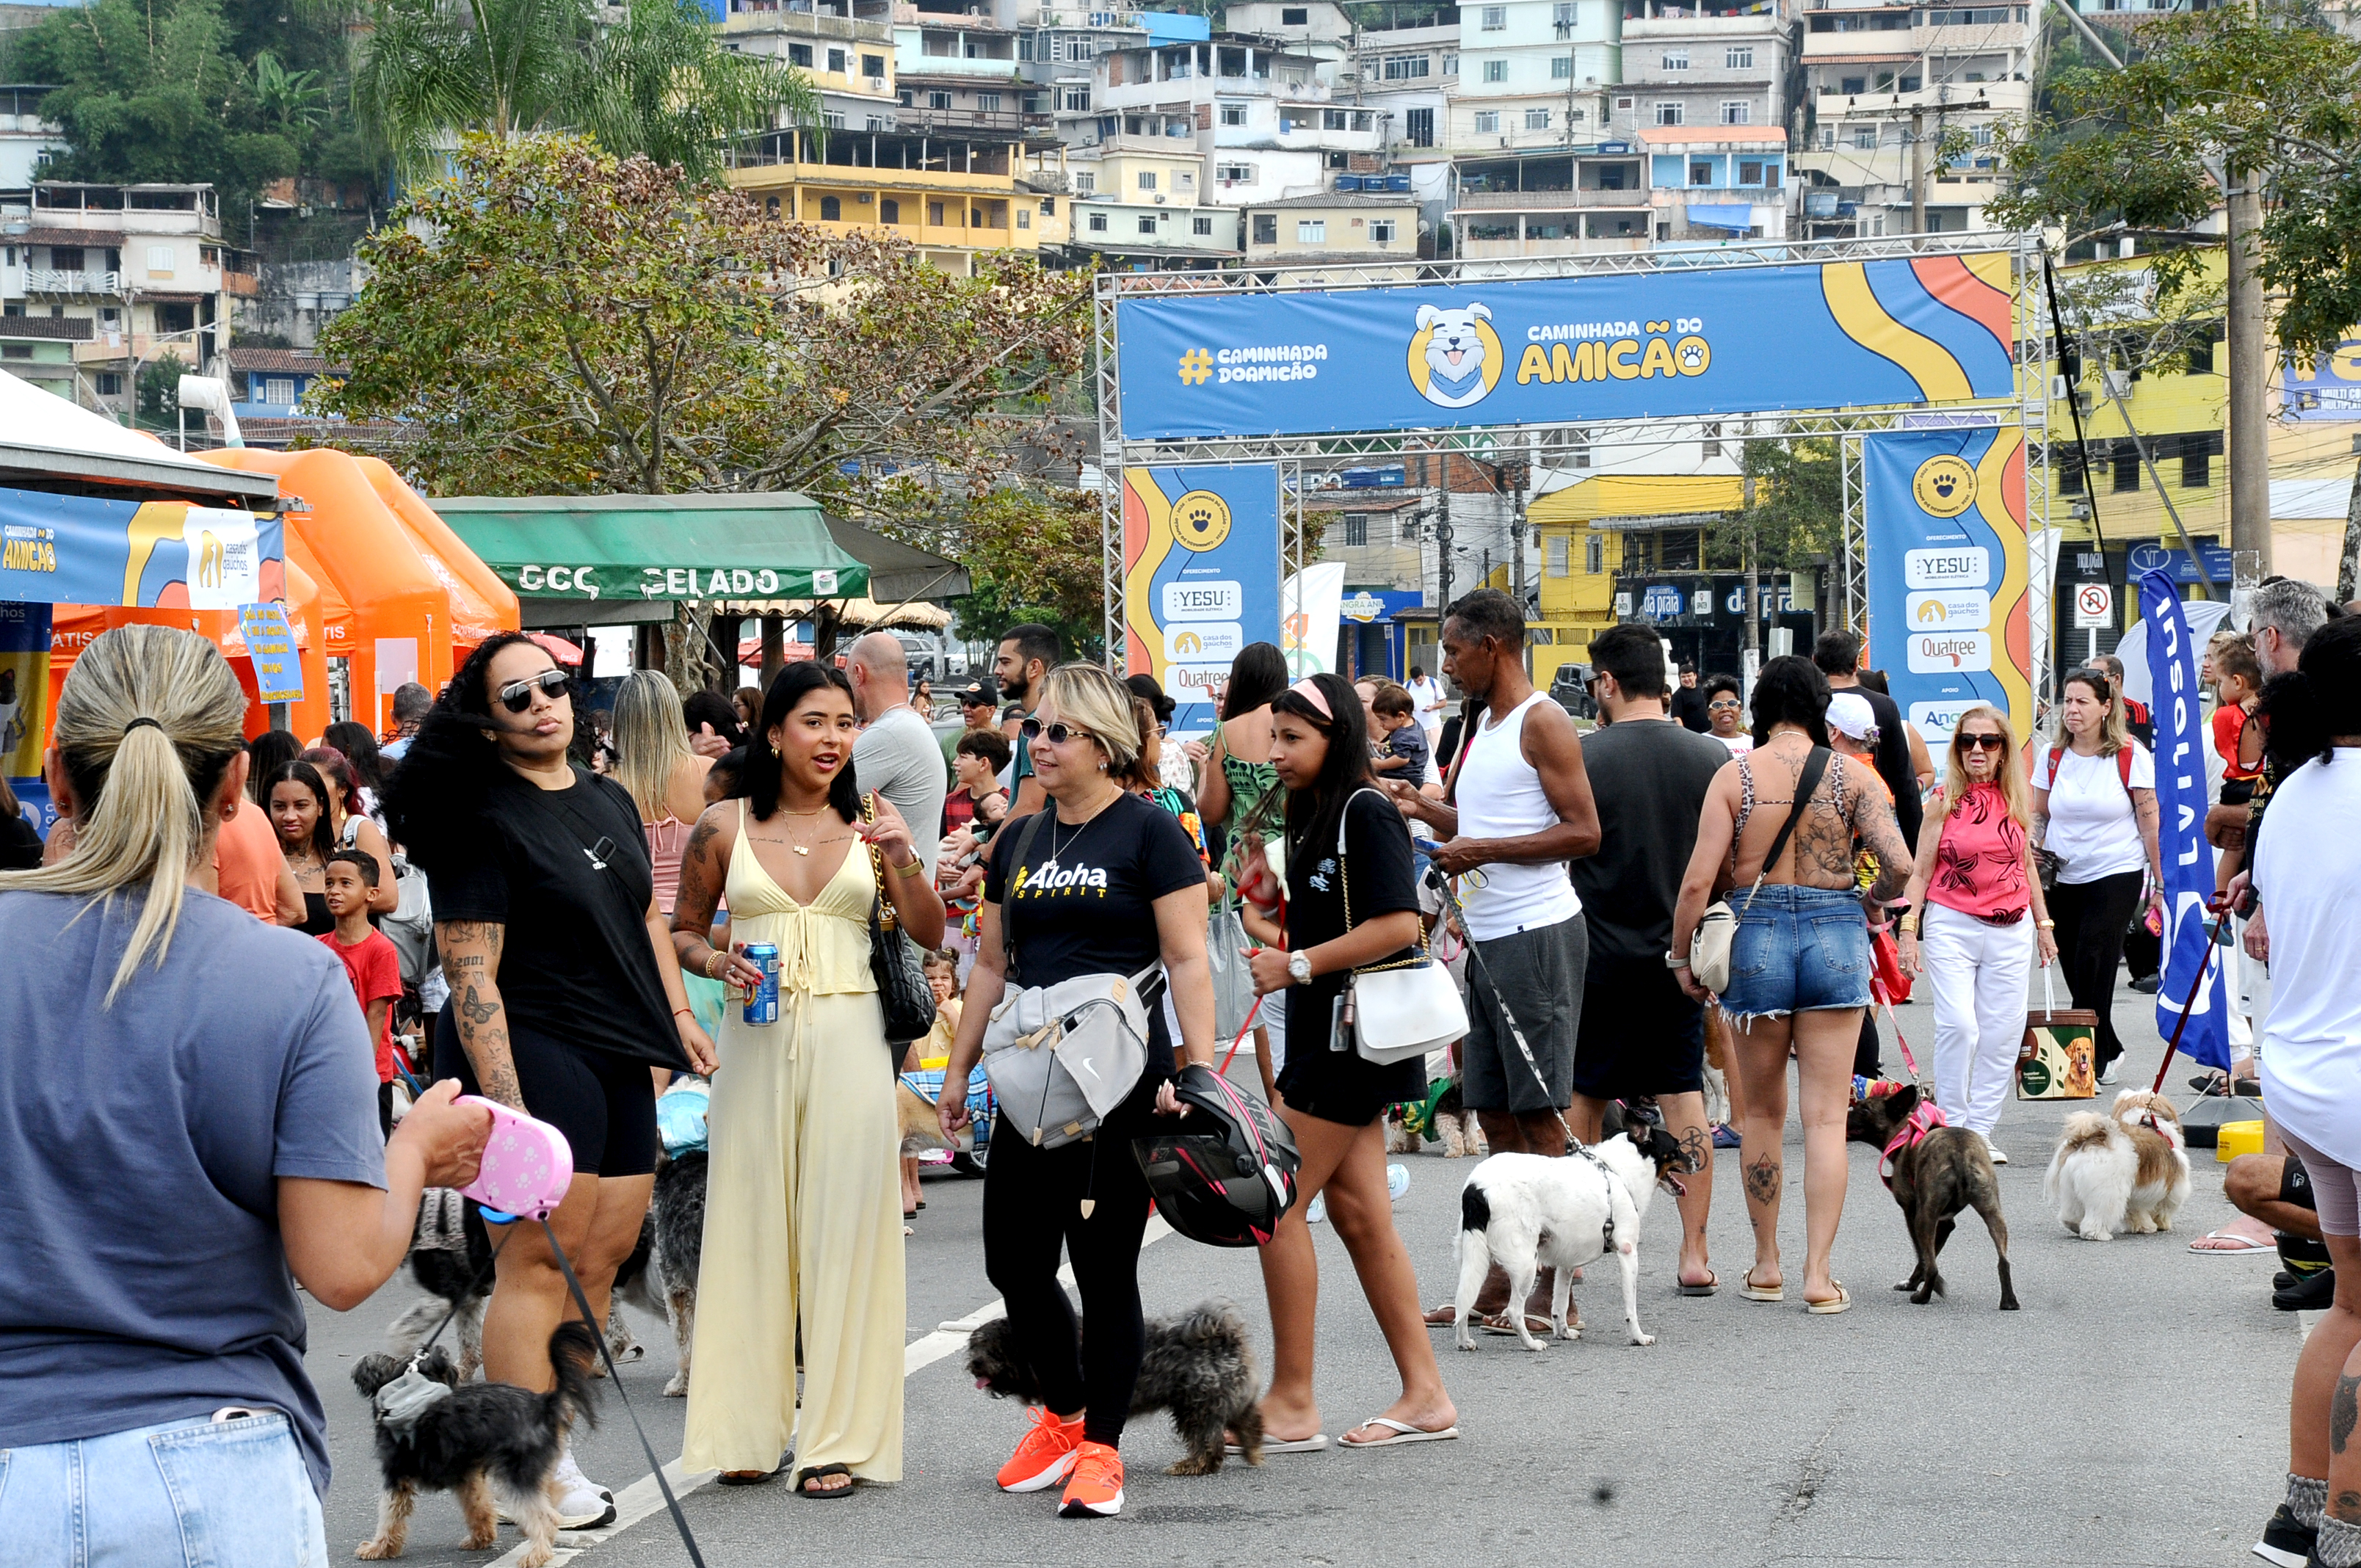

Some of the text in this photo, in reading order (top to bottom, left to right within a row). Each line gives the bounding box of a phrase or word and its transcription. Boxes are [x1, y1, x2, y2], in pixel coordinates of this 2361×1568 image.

[1528, 317, 1702, 341] CAMINHADA DO
[1217, 344, 1327, 364] CAMINHADA
[1516, 320, 1711, 385] AMICÃO
[1217, 361, 1317, 383] DOAMICÃO
[2321, 388, 2347, 399] MULTI
[4, 524, 54, 540] CAMINHADA DO
[1923, 557, 1970, 574] YESU
[2077, 553, 2103, 568] TRILOGIA
[1179, 591, 1225, 606] YESU
[1644, 589, 1679, 618] da praia
[1948, 608, 1979, 617] gaúchos
[1203, 640, 1233, 650] gaúchos
[1922, 638, 1976, 662] Quatree
[1022, 862, 1108, 888] Aloha
[1017, 886, 1106, 899] SPIRIT
